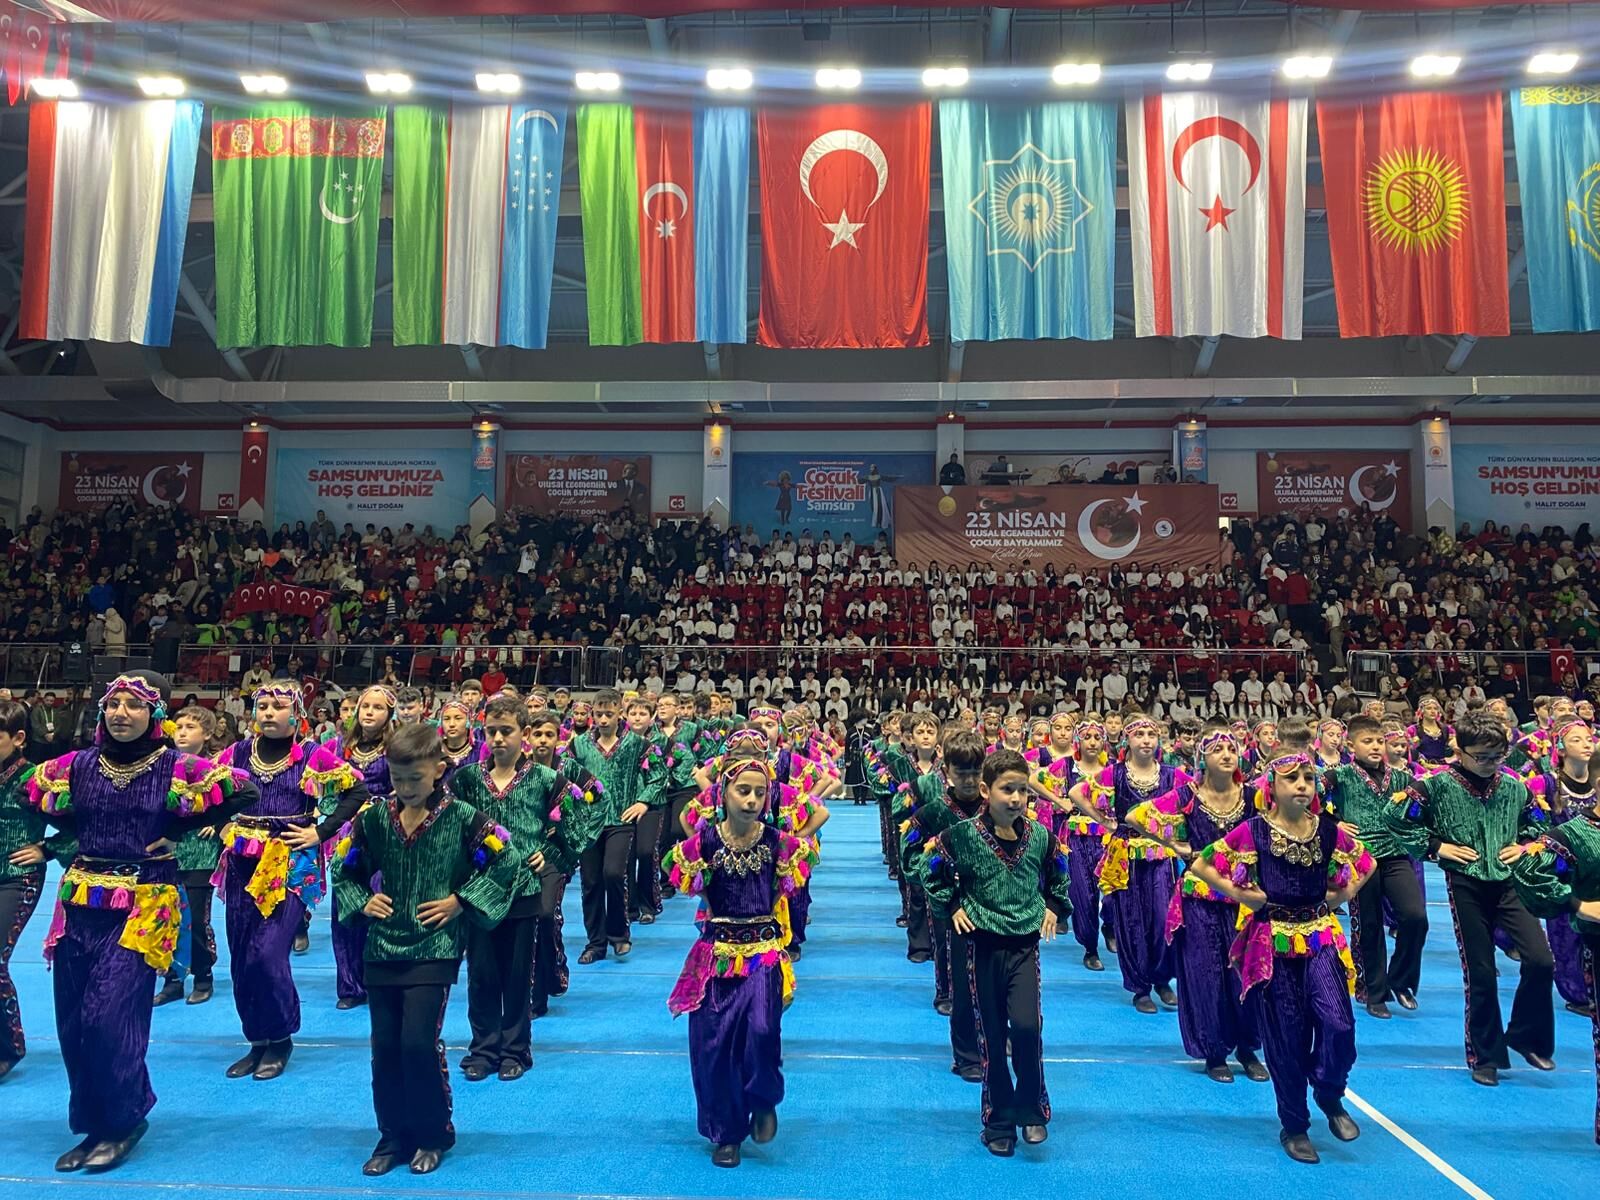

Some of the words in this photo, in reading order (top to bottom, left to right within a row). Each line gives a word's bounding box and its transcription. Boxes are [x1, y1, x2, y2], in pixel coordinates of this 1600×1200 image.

[75, 475, 91, 488] 23
[95, 473, 140, 488] NİSAN
[308, 469, 444, 482] SAMSUN'UMUZA
[548, 468, 565, 480] 23
[805, 467, 860, 487] Çocuk
[1274, 475, 1293, 489] 23
[1296, 473, 1345, 489] NİSAN
[318, 484, 353, 499] HOŞ
[357, 481, 433, 497] GELDİNİZ
[796, 482, 866, 502] Festivali
[1490, 481, 1530, 497] HOŞ
[219, 496, 233, 507] C4
[670, 498, 685, 508] C3
[806, 501, 856, 511] Samsun
[1221, 496, 1238, 507] C2
[966, 511, 992, 528] 23
[997, 509, 1066, 528] NİSAN
[965, 529, 999, 537] ULUSAL
[1000, 528, 1052, 537] EGEMENLİK
[1052, 529, 1065, 537] VE
[969, 539, 1002, 548] ÇOCUK
[1003, 539, 1063, 547] BAYRAMIMIZ
